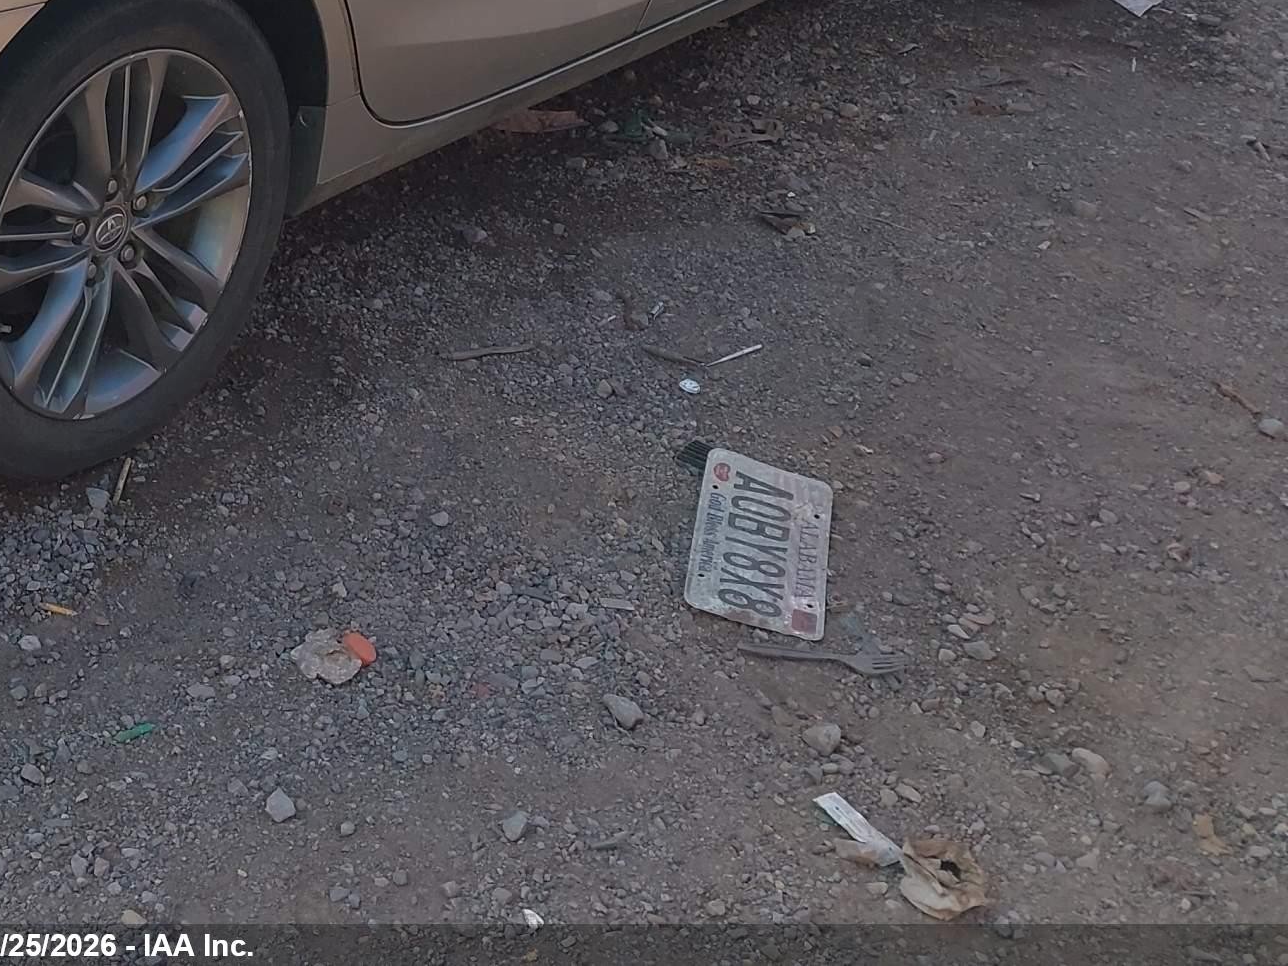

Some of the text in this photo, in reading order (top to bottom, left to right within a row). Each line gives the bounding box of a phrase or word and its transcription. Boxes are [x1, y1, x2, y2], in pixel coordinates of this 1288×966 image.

[697, 491, 727, 574] God Bless America
[795, 521, 819, 599] ALABAMA
